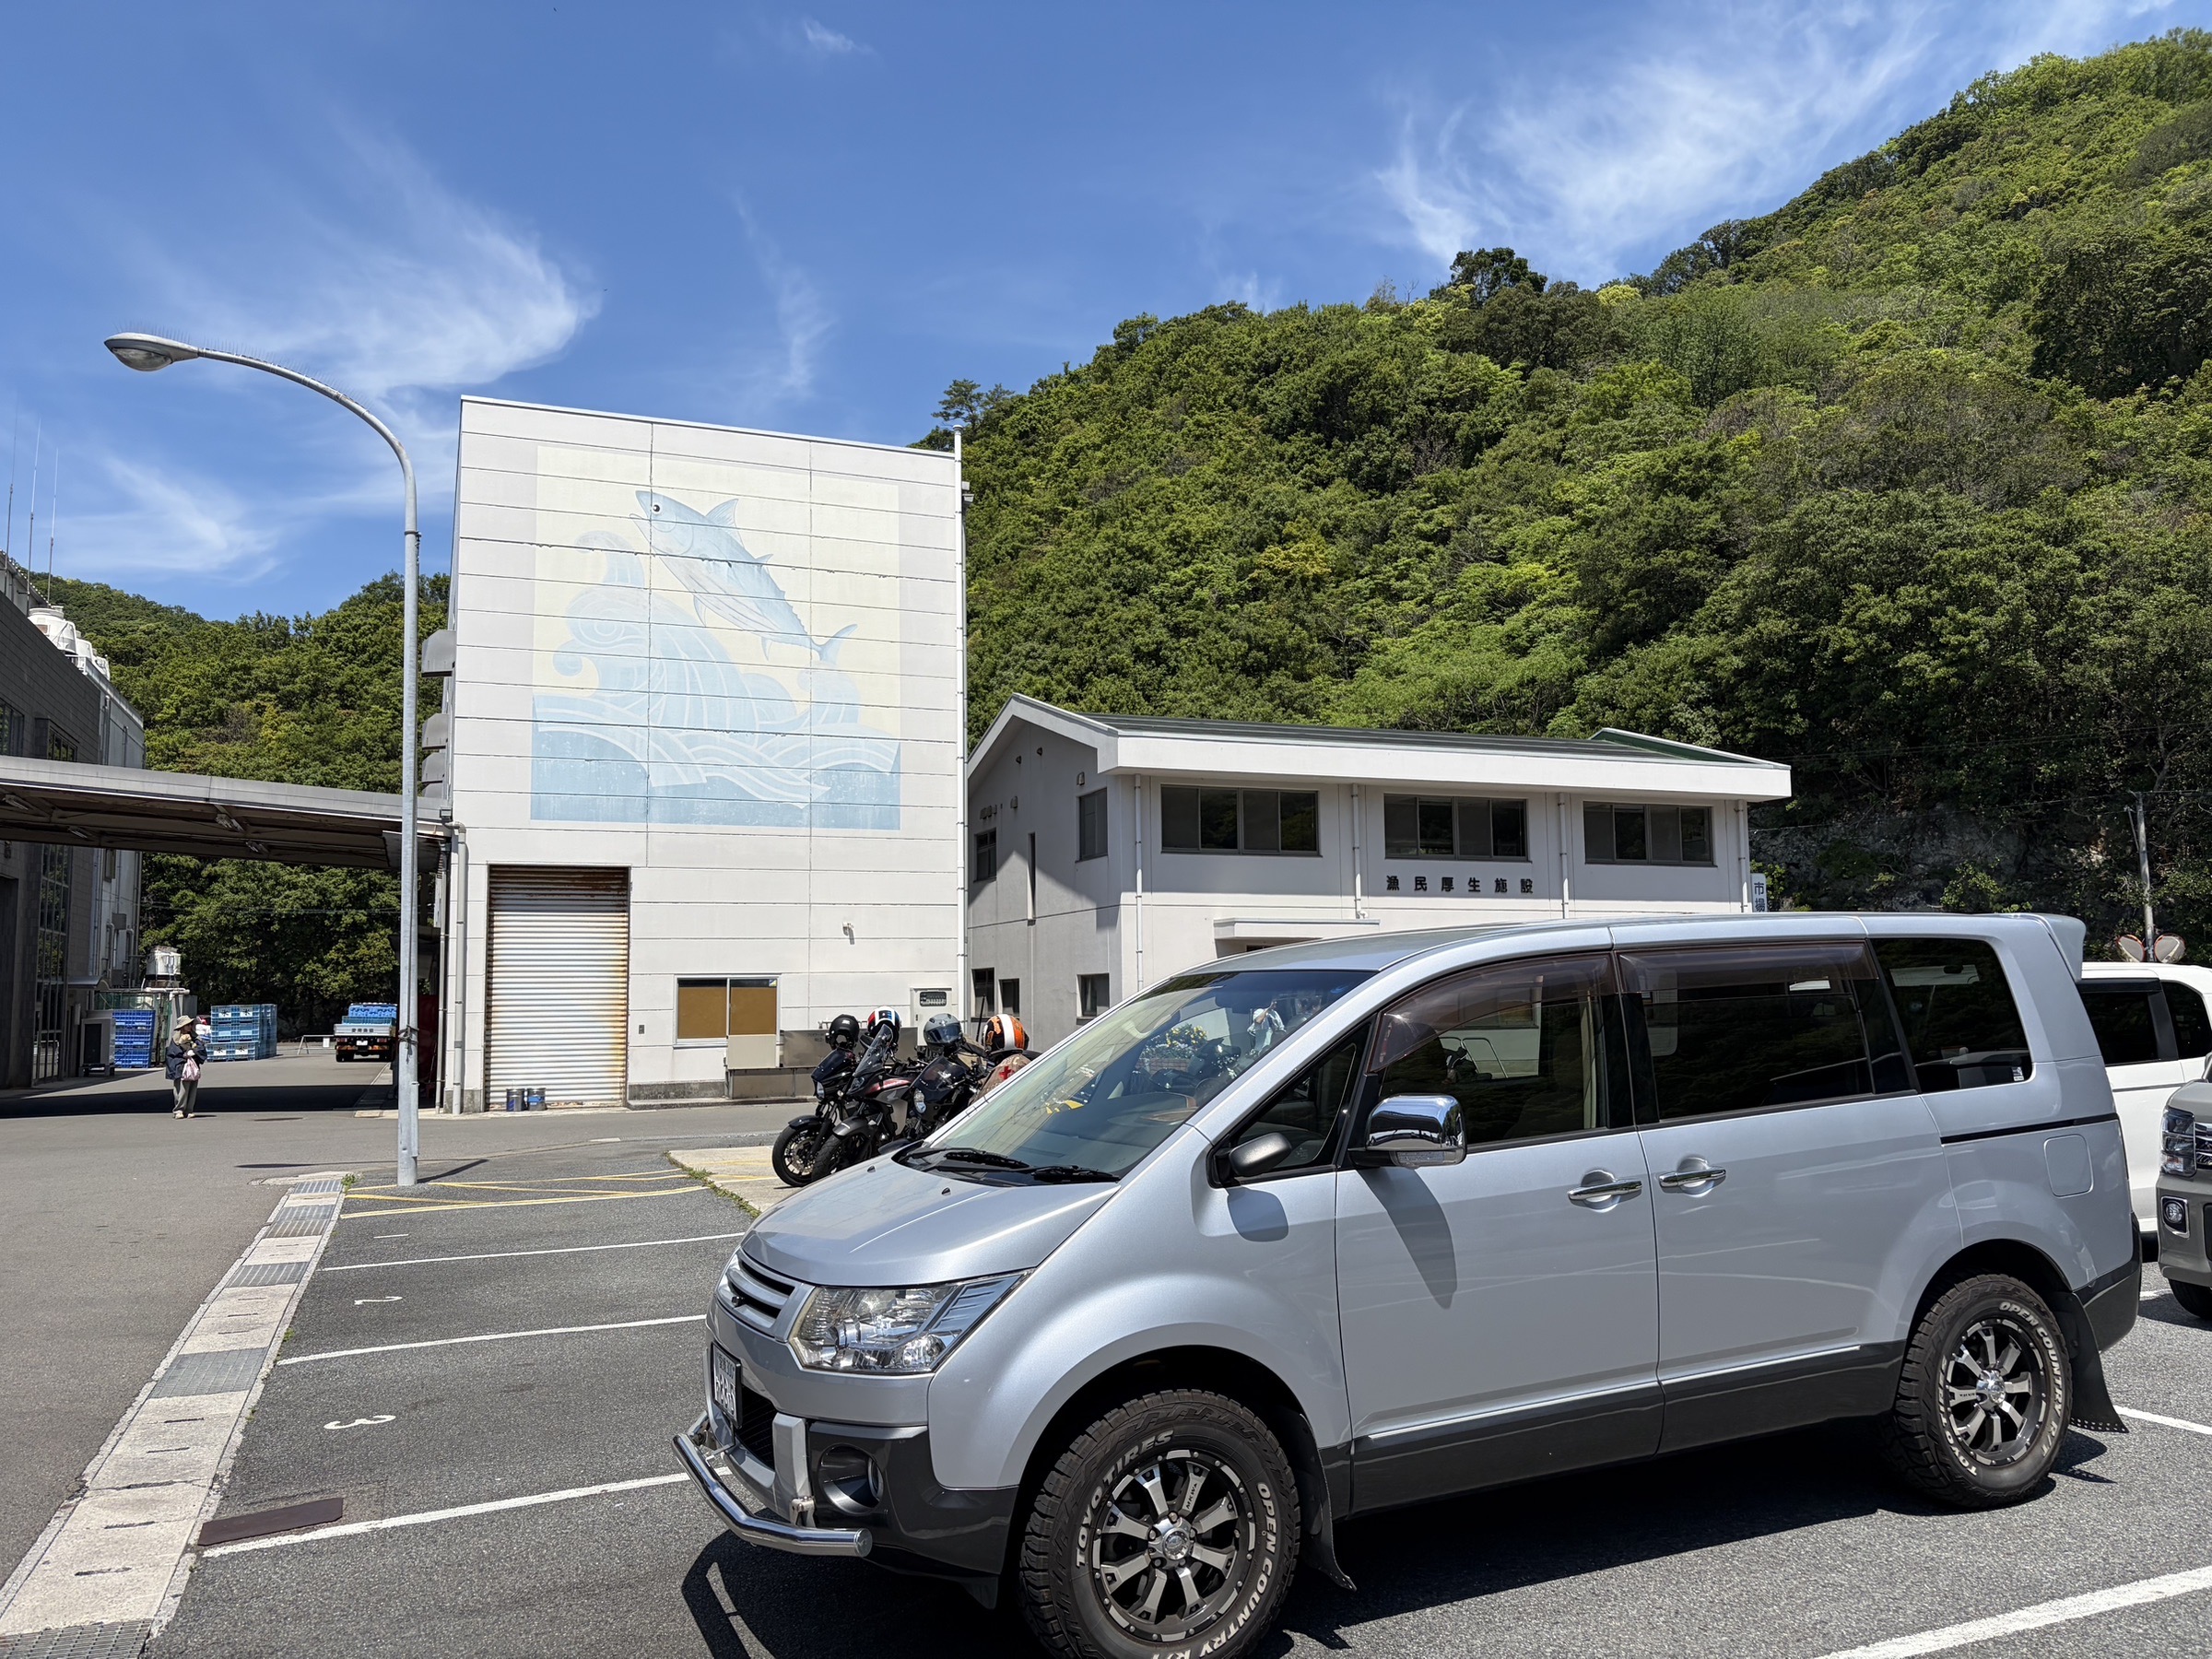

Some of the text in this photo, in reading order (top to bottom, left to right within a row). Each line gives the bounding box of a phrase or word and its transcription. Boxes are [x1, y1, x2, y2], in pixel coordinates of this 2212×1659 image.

[1386, 876, 1533, 893] 漁民厚生施設
[1754, 881, 1765, 912] 市場
[1999, 1301, 2063, 1457] OPEN COUNTRY R/T
[1945, 1430, 1977, 1476] TOYO
[1076, 1430, 1174, 1567] TOYO TIRES
[1257, 1482, 1277, 1554] OPEN
[1199, 1557, 1273, 1657] COUNTRY
